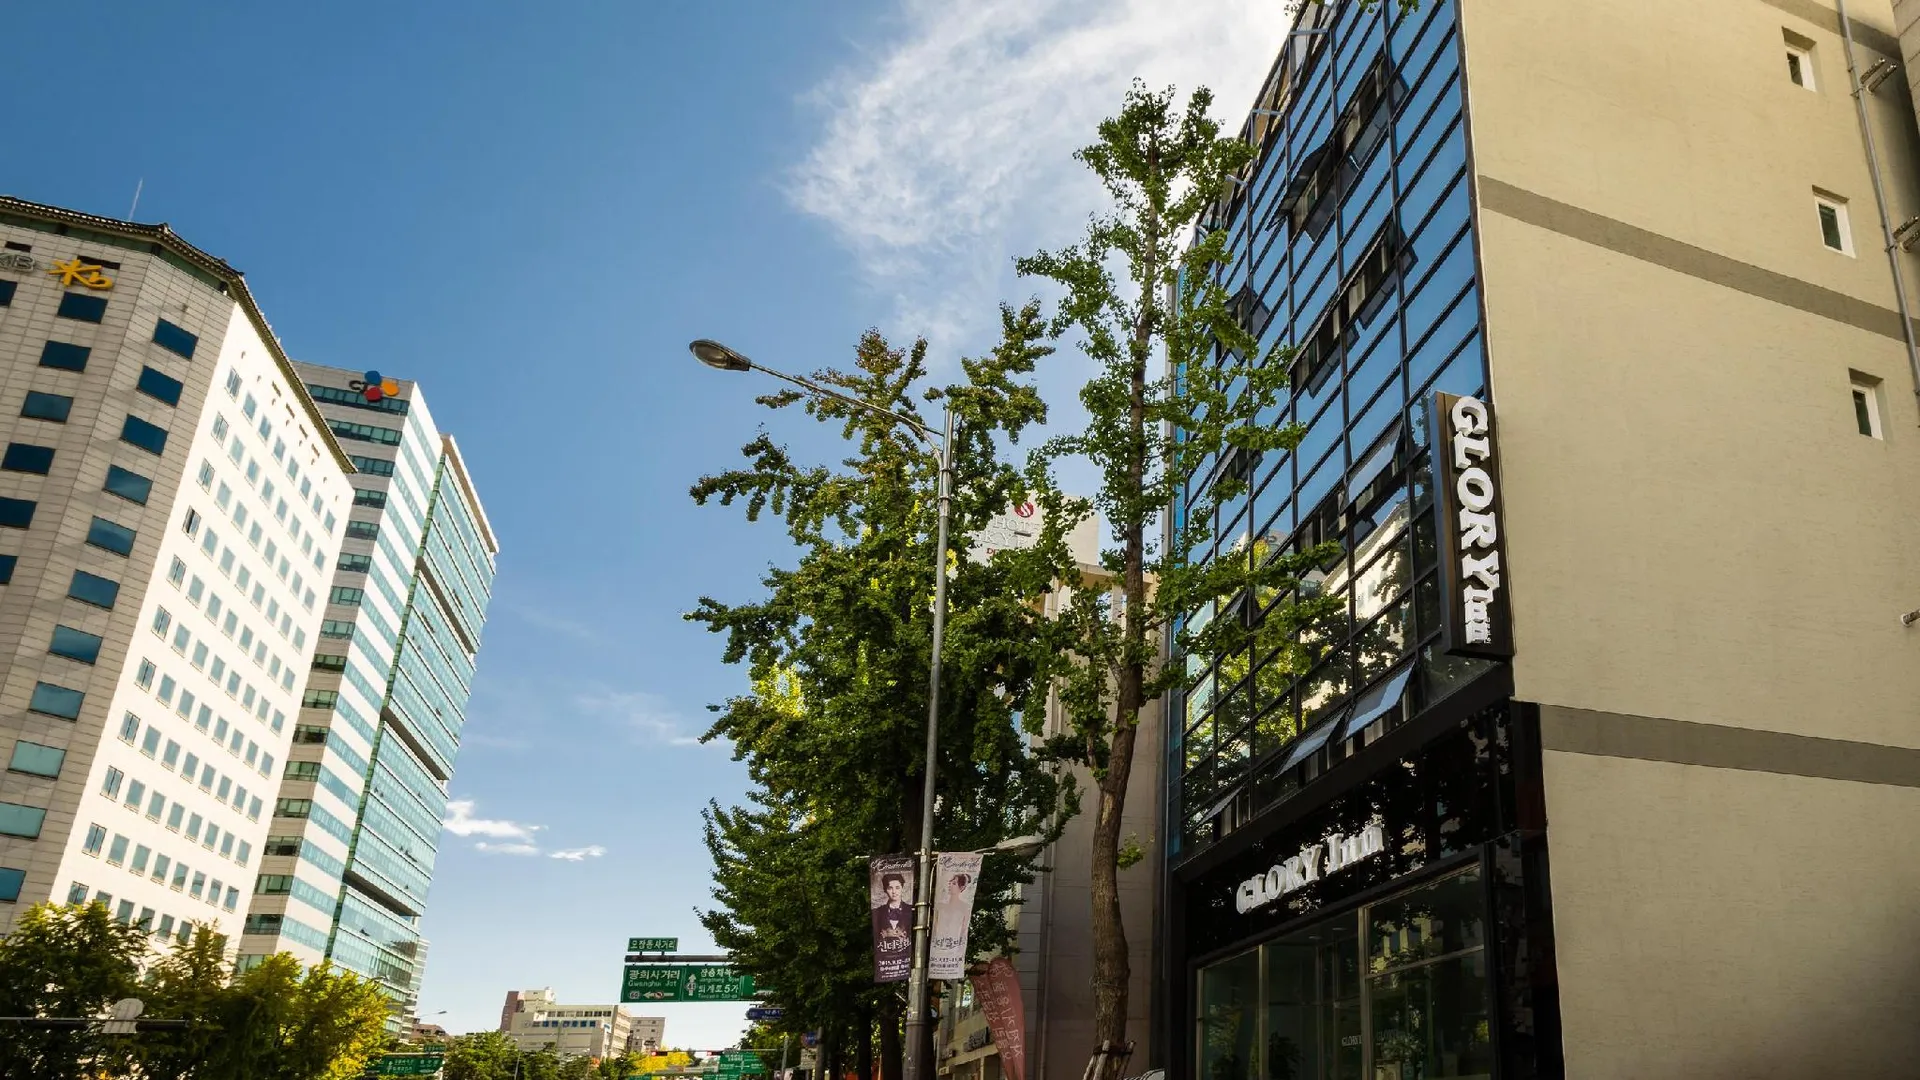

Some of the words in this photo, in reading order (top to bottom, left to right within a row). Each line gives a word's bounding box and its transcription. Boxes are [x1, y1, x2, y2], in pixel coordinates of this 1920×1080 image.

[1451, 396, 1500, 590] GLORY
[1236, 844, 1324, 915] GLORY
[1326, 824, 1385, 877] Inn
[629, 969, 681, 980] 광희사거리
